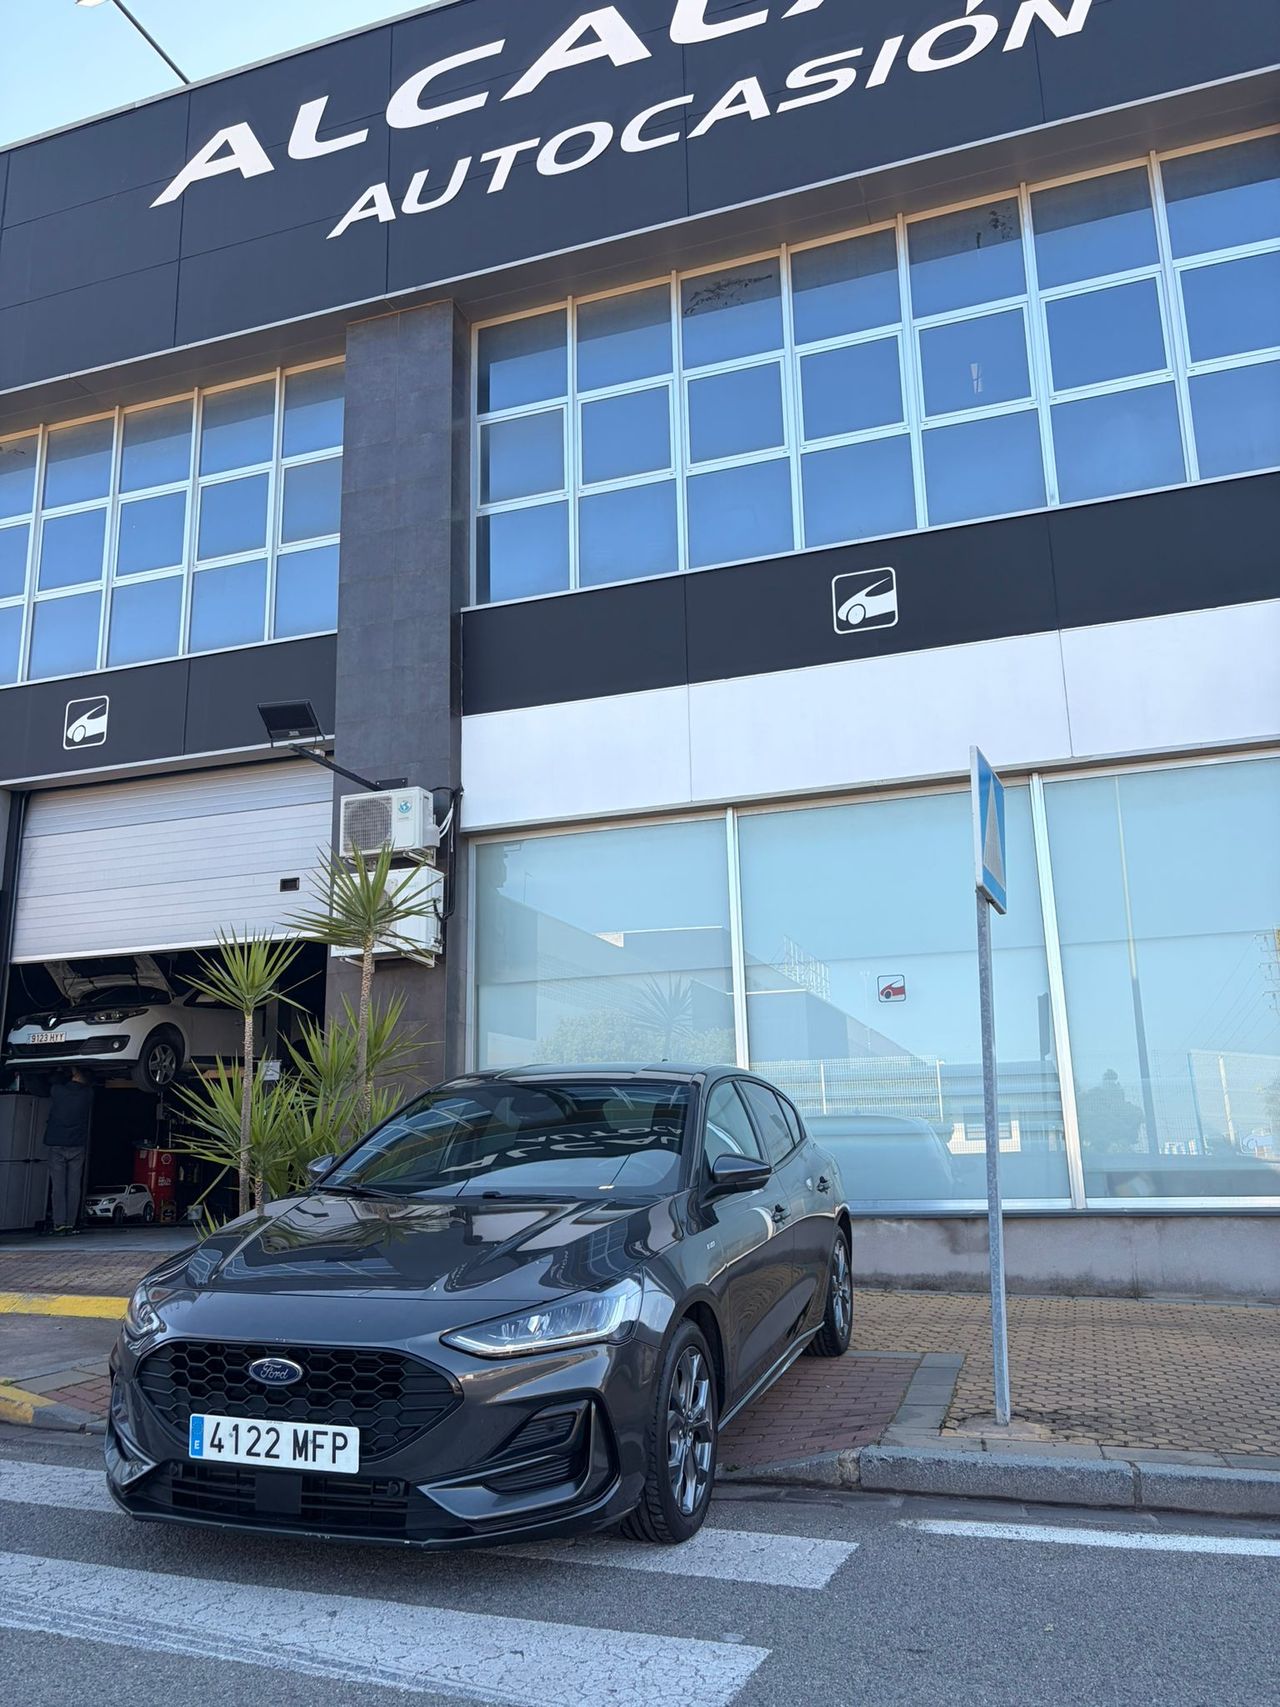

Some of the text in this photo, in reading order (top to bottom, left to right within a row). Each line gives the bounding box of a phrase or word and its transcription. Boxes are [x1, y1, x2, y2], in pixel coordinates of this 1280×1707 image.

[150, 0, 824, 208] ALCAL
[327, 0, 1092, 240] AUTOCASIÓN
[31, 1033, 48, 1043] 9123
[260, 1361, 289, 1379] Ford
[194, 1440, 200, 1450] E
[209, 1421, 349, 1465] 4122 MFP
